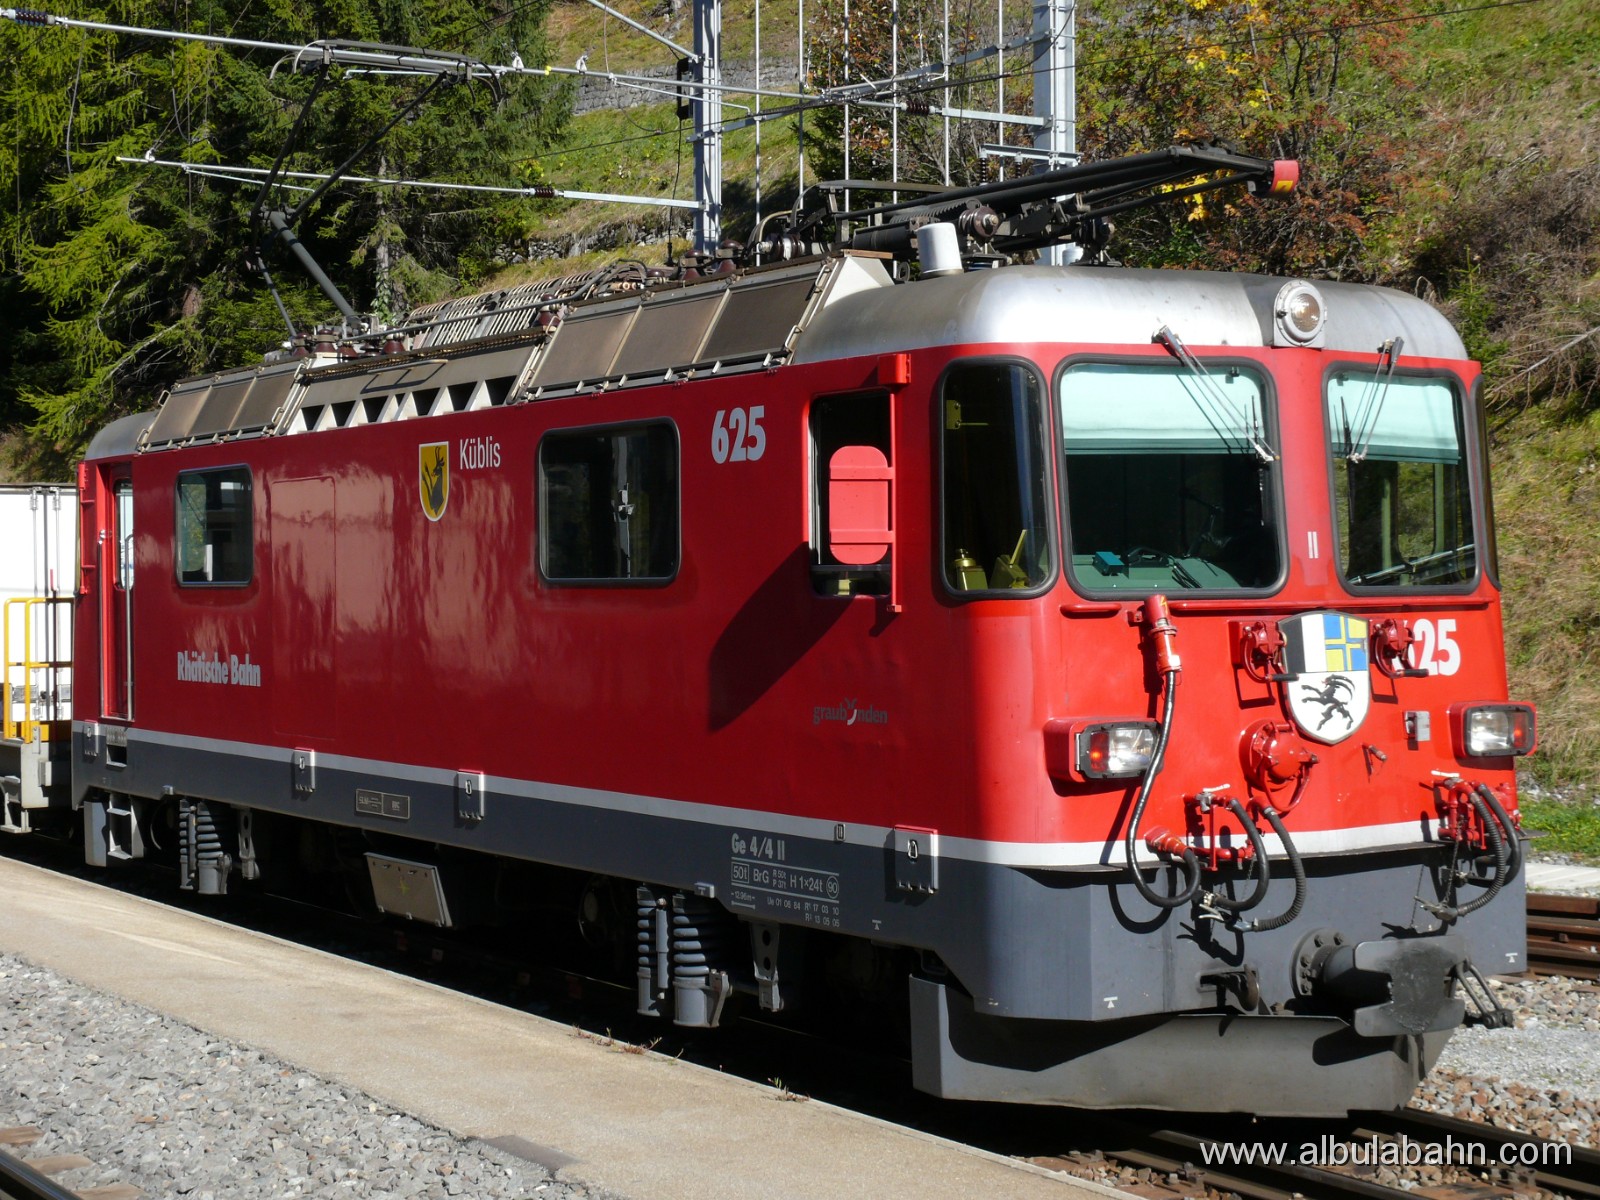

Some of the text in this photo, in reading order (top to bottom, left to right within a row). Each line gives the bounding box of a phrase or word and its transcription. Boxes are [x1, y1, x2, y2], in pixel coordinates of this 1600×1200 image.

[711, 405, 766, 464] 625
[459, 436, 501, 470] Küblis
[177, 650, 261, 687] Rhätische Bahn
[731, 833, 746, 855] Ge
[750, 836, 773, 859] 4/4
[733, 865, 769, 884] 50t BrG
[790, 874, 797, 888] H
[828, 880, 838, 894] 90
